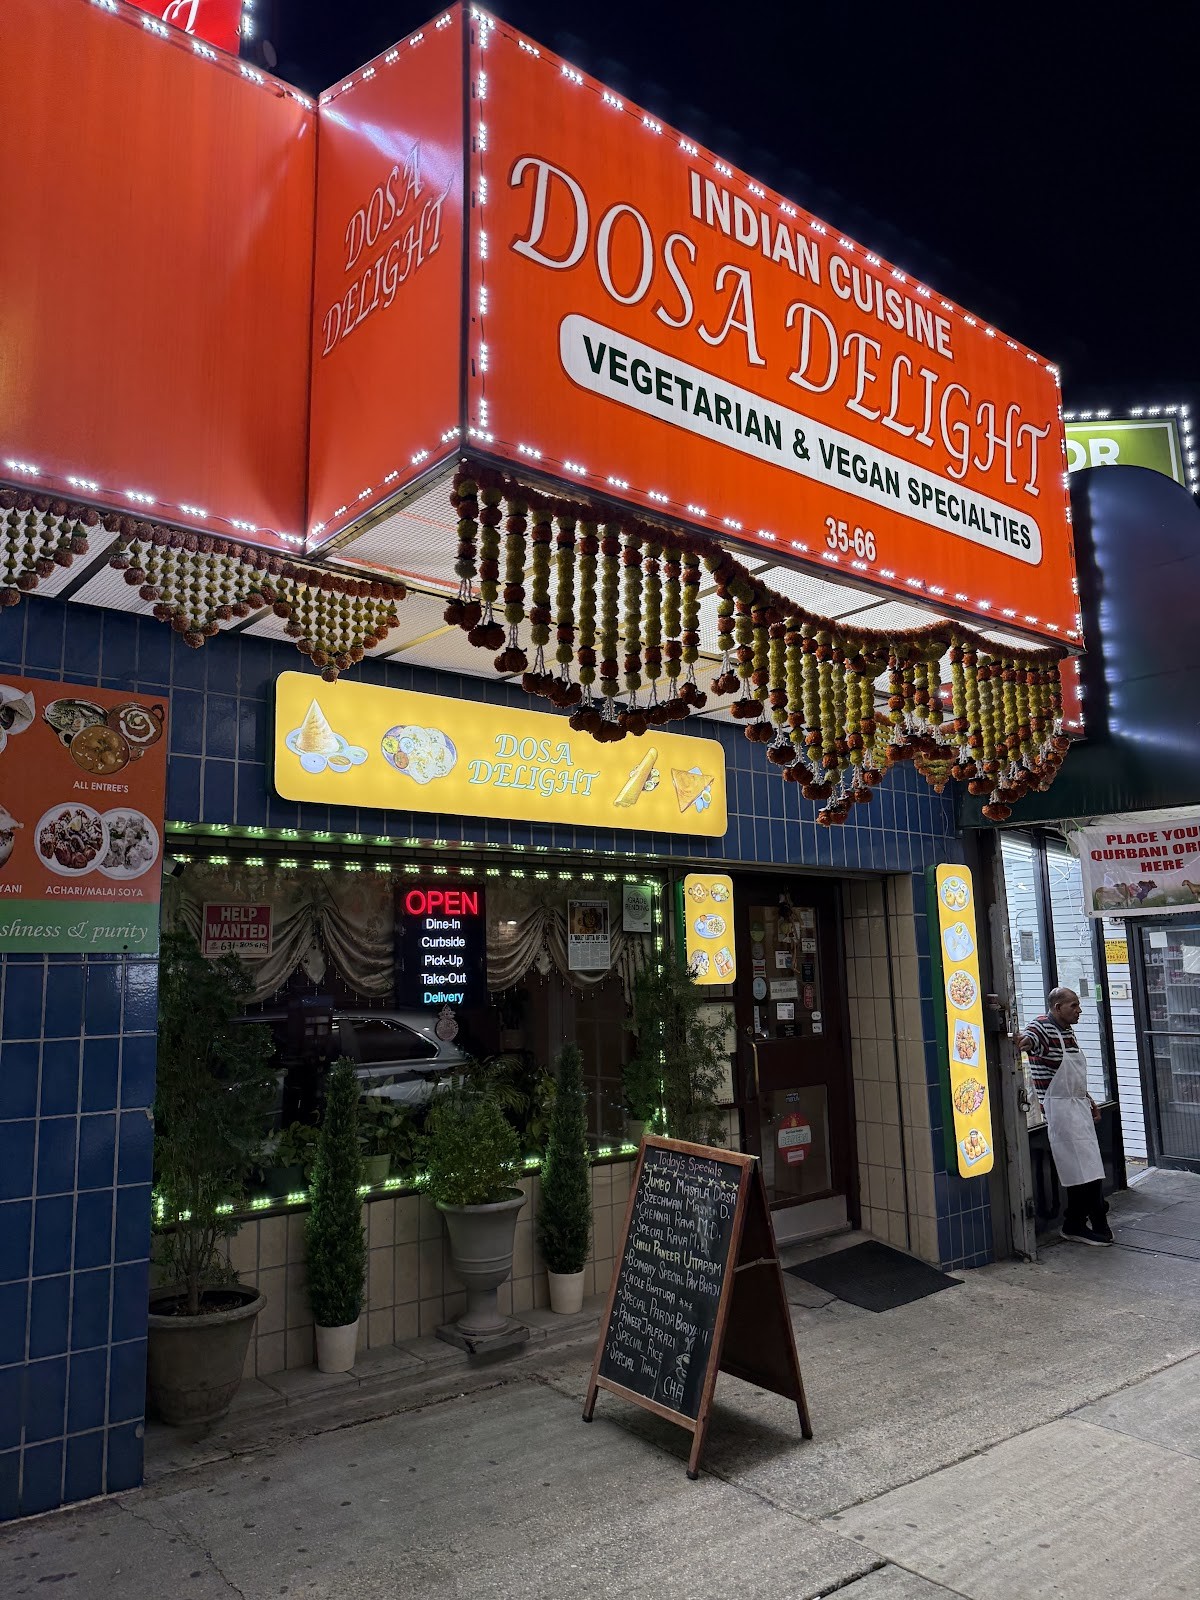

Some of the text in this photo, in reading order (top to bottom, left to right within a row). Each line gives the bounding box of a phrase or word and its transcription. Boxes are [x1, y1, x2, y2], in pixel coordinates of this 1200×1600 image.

[344, 141, 423, 272] DOSA
[321, 173, 455, 357] DELIGHT
[689, 170, 954, 360] INDIAN CUISINE
[510, 156, 1051, 496] DOSA DELIGHT
[582, 335, 1032, 550] VEGETARIAN & VEGAN SPECIALTIES
[825, 516, 877, 561] 35-66
[495, 733, 574, 766] DOSA
[73, 781, 129, 793] ALL ENTREE'S
[468, 760, 601, 797] DELIGHT
[1106, 826, 1200, 845] PLACE YOU
[1091, 841, 1200, 862] QURBANI OR
[1140, 858, 1185, 872] HERE
[46, 885, 143, 897] ACHARI/MALAI SOYA
[405, 890, 479, 916] OPEN
[220, 907, 258, 922] HELP
[426, 918, 461, 930] Dine-In
[67, 920, 91, 939] &
[91, 922, 149, 944] purity
[208, 924, 268, 938] WANTED
[421, 937, 465, 948] Curbside
[424, 955, 463, 968] Pick-Up
[421, 973, 466, 984] Take-Out
[423, 992, 464, 1005] Delivery
[655, 1151, 723, 1178] Today's Specials
[643, 1186, 684, 1210] SZECHWAN
[644, 1170, 737, 1205] JUMBO MASALA DOSA
[638, 1201, 672, 1226] CHENNAI
[674, 1210, 696, 1231] RAVA
[636, 1216, 664, 1241] SPECIAL
[666, 1227, 688, 1247] RAVA
[653, 1239, 681, 1265] PANEER
[627, 1248, 657, 1277] BOMBAY
[658, 1261, 685, 1285] SPECIAL
[621, 1283, 648, 1314] SPECIAL
[625, 1267, 676, 1305] CHOLE BHATURA
[618, 1303, 642, 1329] PANEER
[616, 1322, 663, 1363] SPECIAL RICE
[610, 1340, 659, 1378] SPECIAL THALI
